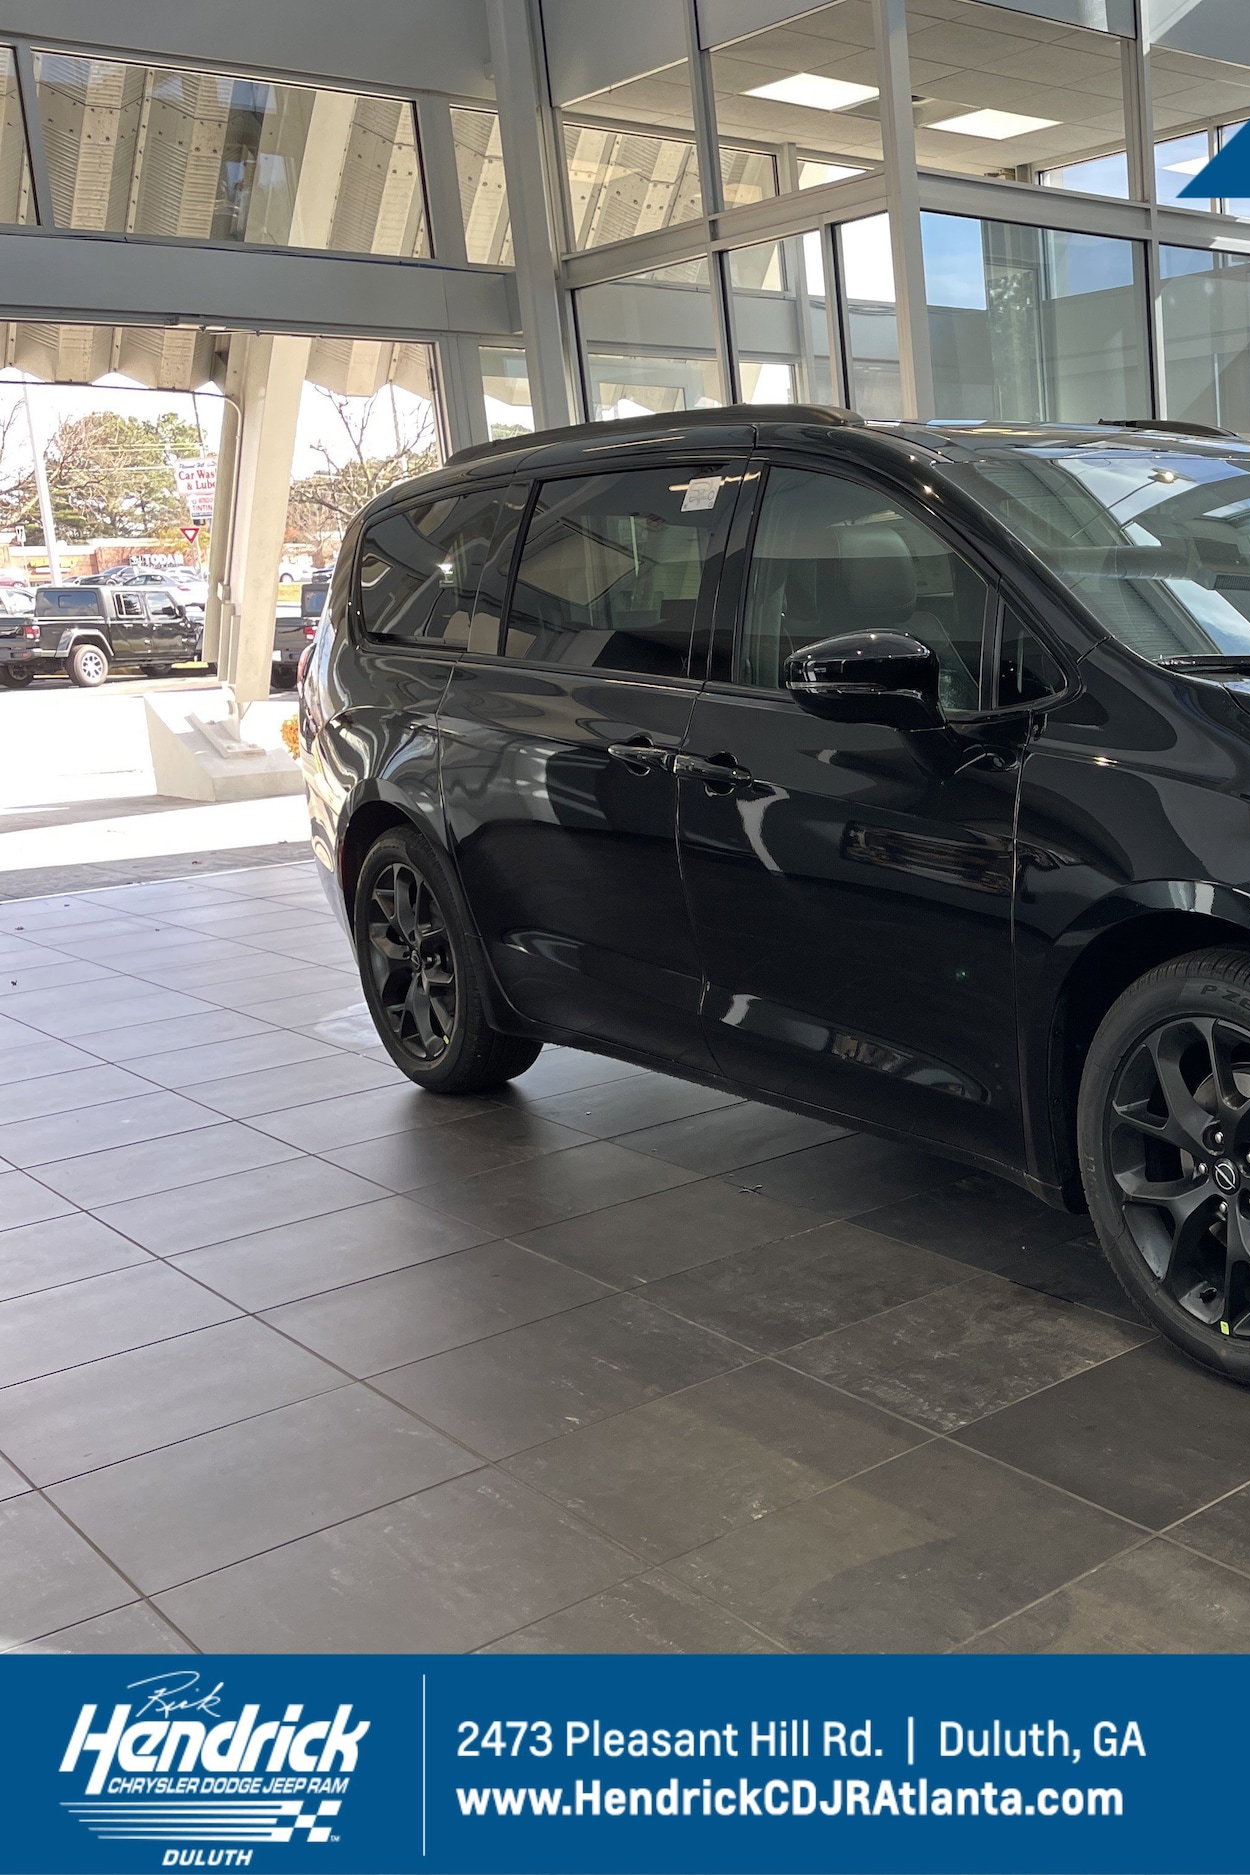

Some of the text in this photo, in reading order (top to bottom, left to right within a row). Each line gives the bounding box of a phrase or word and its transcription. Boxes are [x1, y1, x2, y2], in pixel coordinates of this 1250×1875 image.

[178, 468, 217, 480] Car Was
[186, 482, 192, 490] &
[192, 504, 213, 512] TINTIN
[1200, 984, 1218, 995] P
